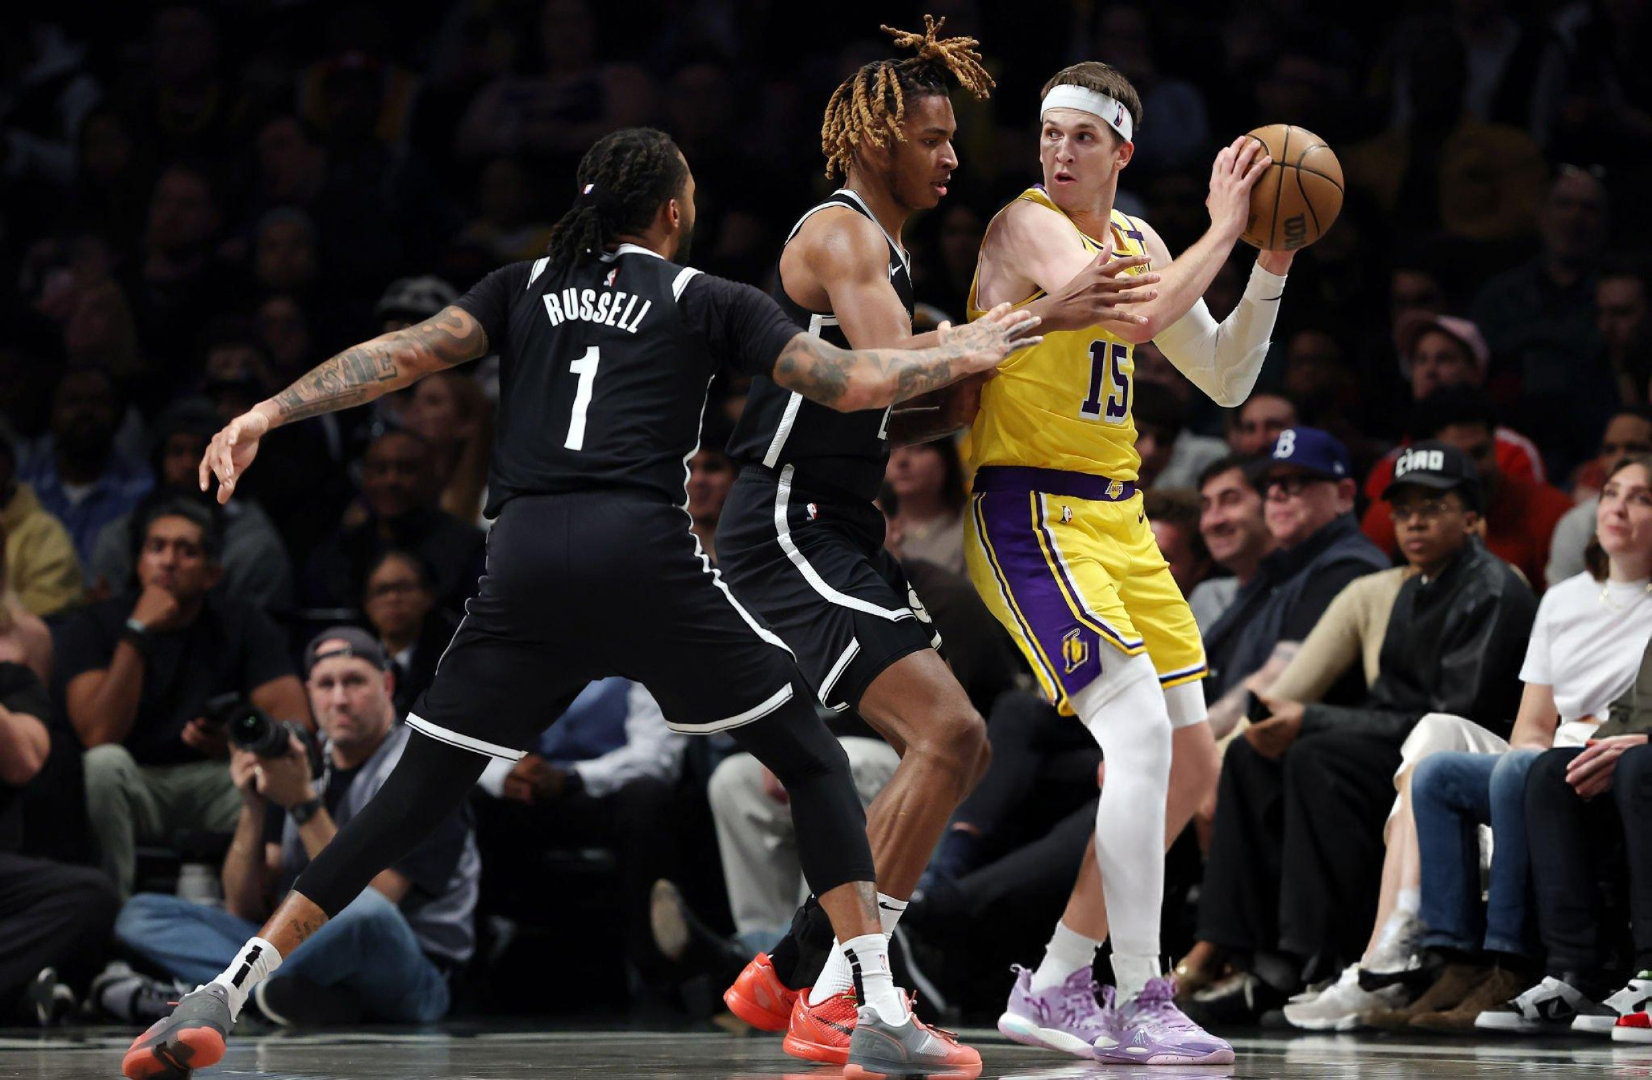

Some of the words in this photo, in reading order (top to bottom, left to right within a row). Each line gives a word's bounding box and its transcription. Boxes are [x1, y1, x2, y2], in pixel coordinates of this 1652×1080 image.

[542, 287, 652, 334] RUSSELL
[563, 345, 600, 451] 1
[1080, 339, 1129, 423] 15
[1273, 429, 1297, 459] B
